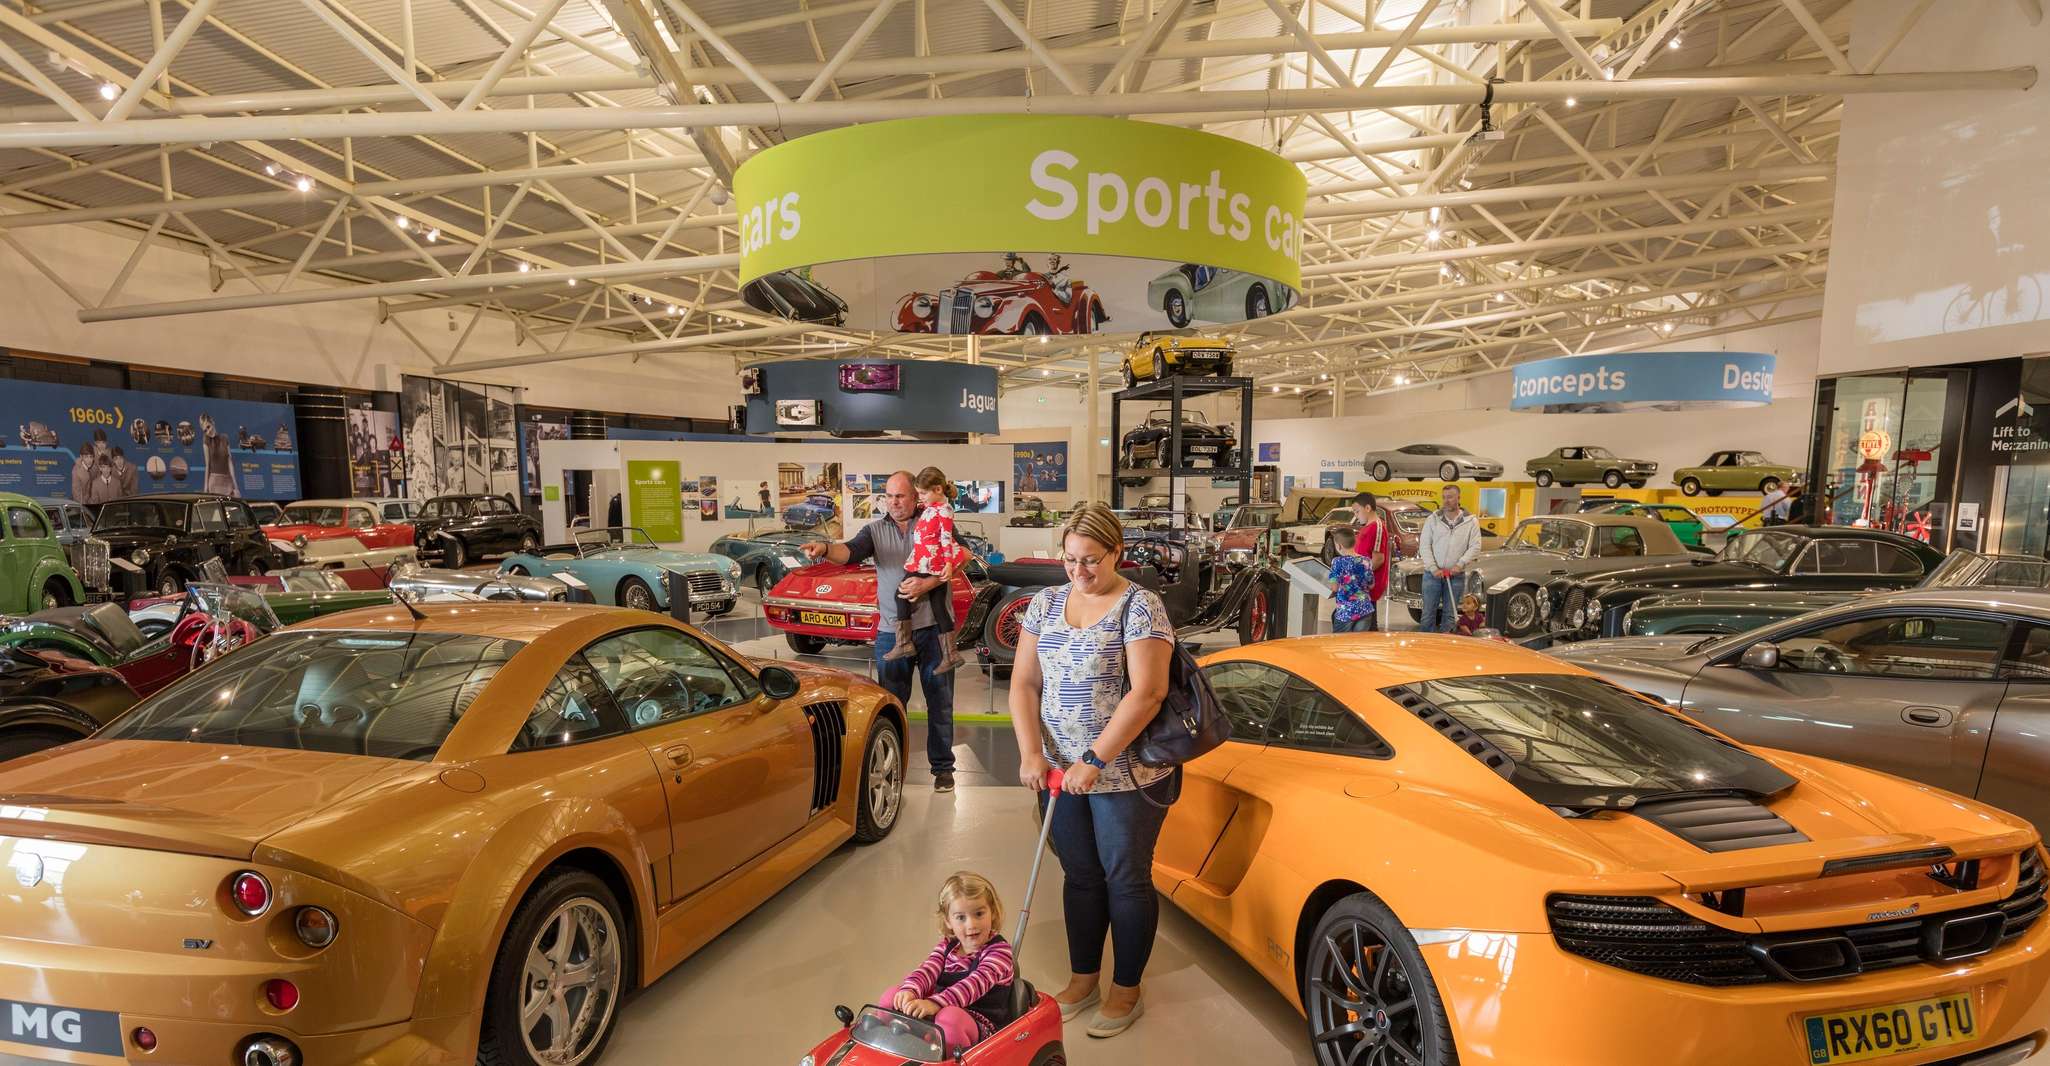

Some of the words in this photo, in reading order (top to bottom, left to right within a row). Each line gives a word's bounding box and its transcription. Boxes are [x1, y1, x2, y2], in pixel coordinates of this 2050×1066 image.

[1024, 149, 1252, 242] Sports
[742, 191, 801, 257] cars
[1520, 366, 1626, 397] concepts
[69, 407, 114, 425] 1960s
[1993, 426, 2014, 438] Lift
[2017, 426, 2031, 437] to
[1991, 439, 2050, 451] Mezzanin
[1320, 459, 1335, 467] Gas
[635, 479, 654, 487] Sports
[817, 585, 831, 593] GB
[804, 613, 820, 623] ARO
[11, 1003, 82, 1043] MG
[1828, 1008, 1913, 1057] RX60
[1918, 998, 1973, 1041] GTU
[1812, 1049, 1828, 1060] GB
